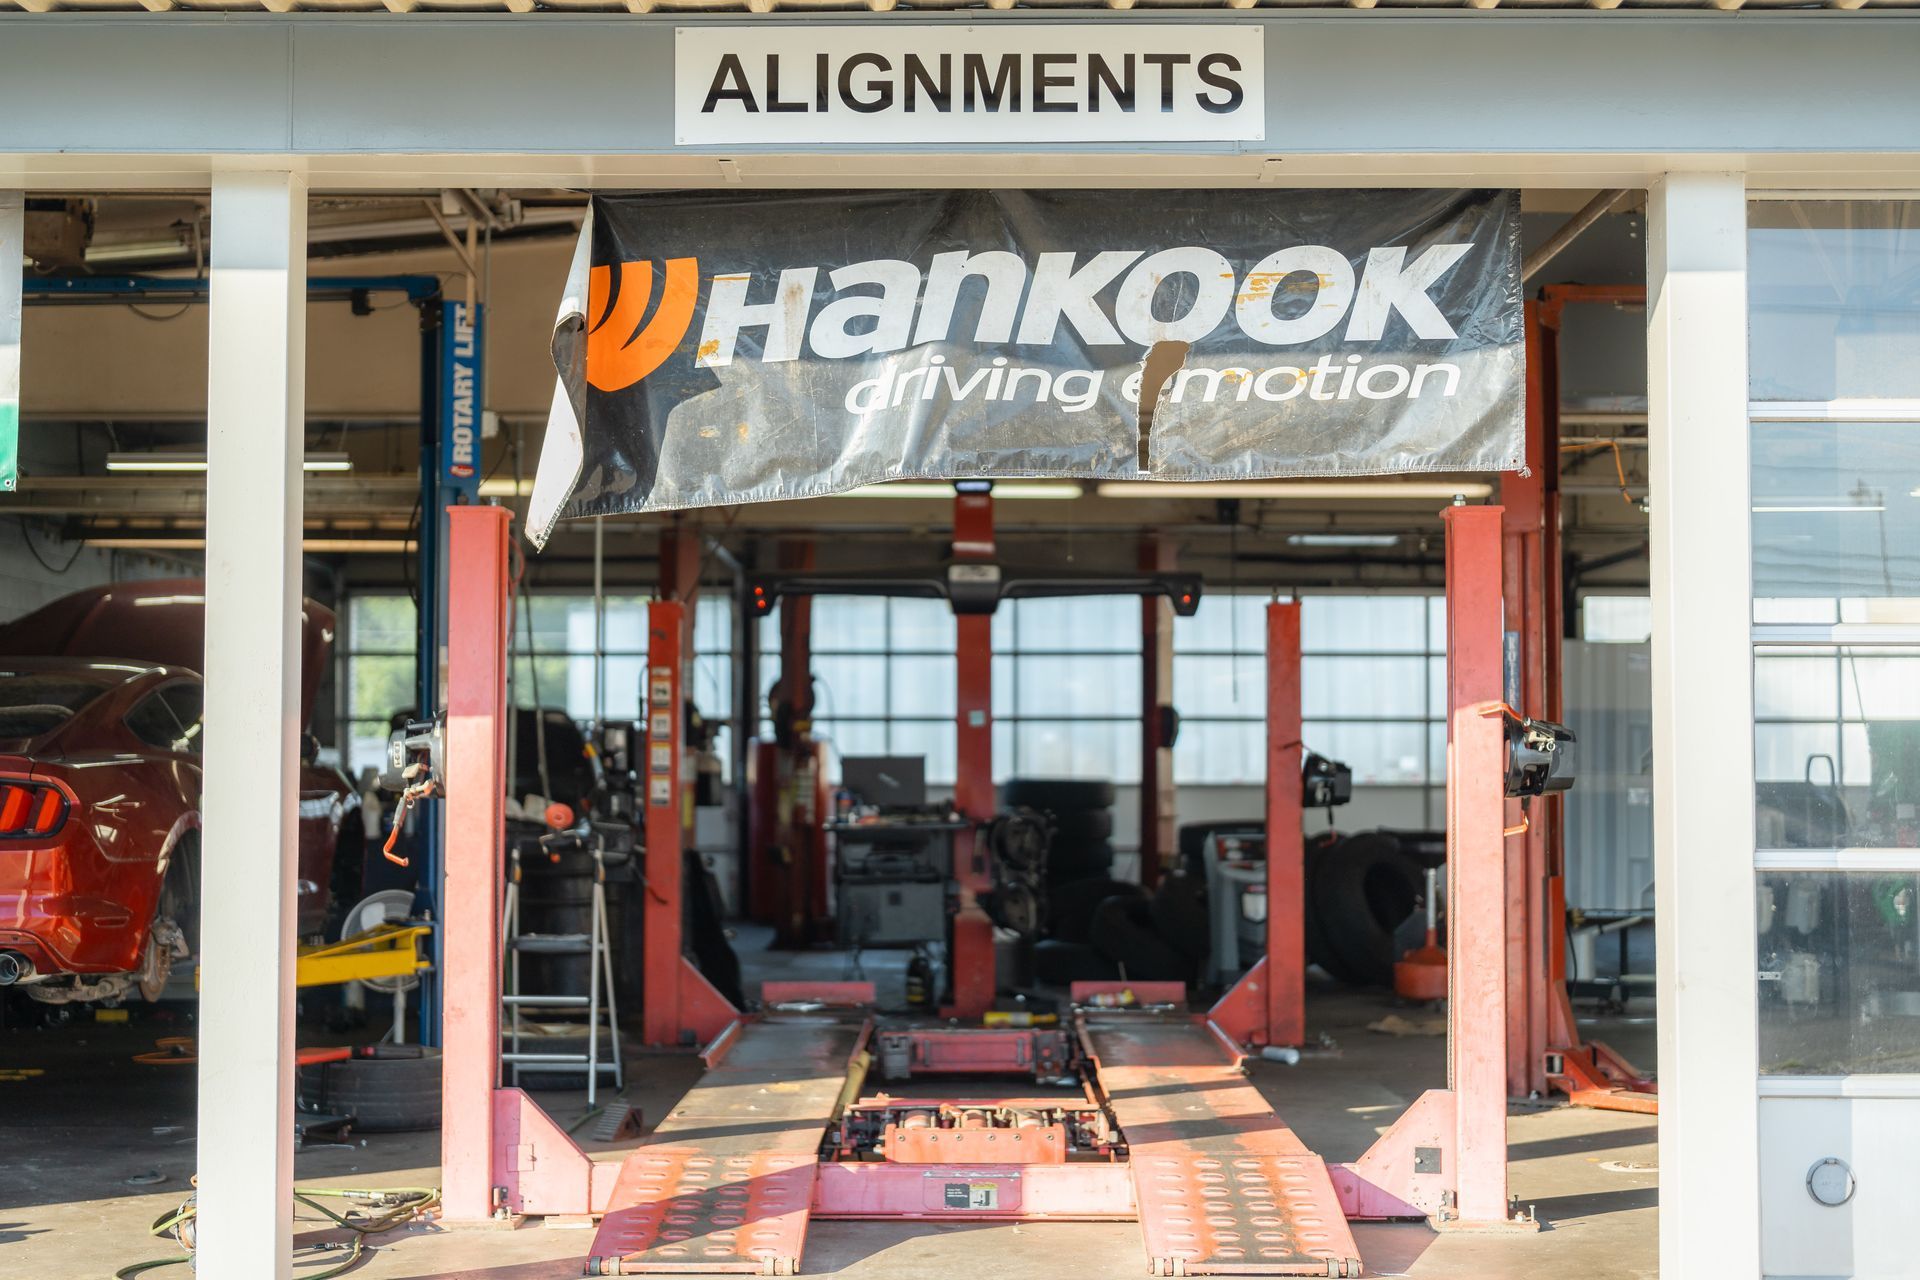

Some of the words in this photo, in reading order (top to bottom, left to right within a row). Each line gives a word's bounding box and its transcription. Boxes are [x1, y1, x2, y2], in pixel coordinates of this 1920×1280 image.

[701, 52, 1244, 113] ALIGNMENTS
[453, 363, 474, 463] ROTARY
[845, 354, 1105, 413] driving
